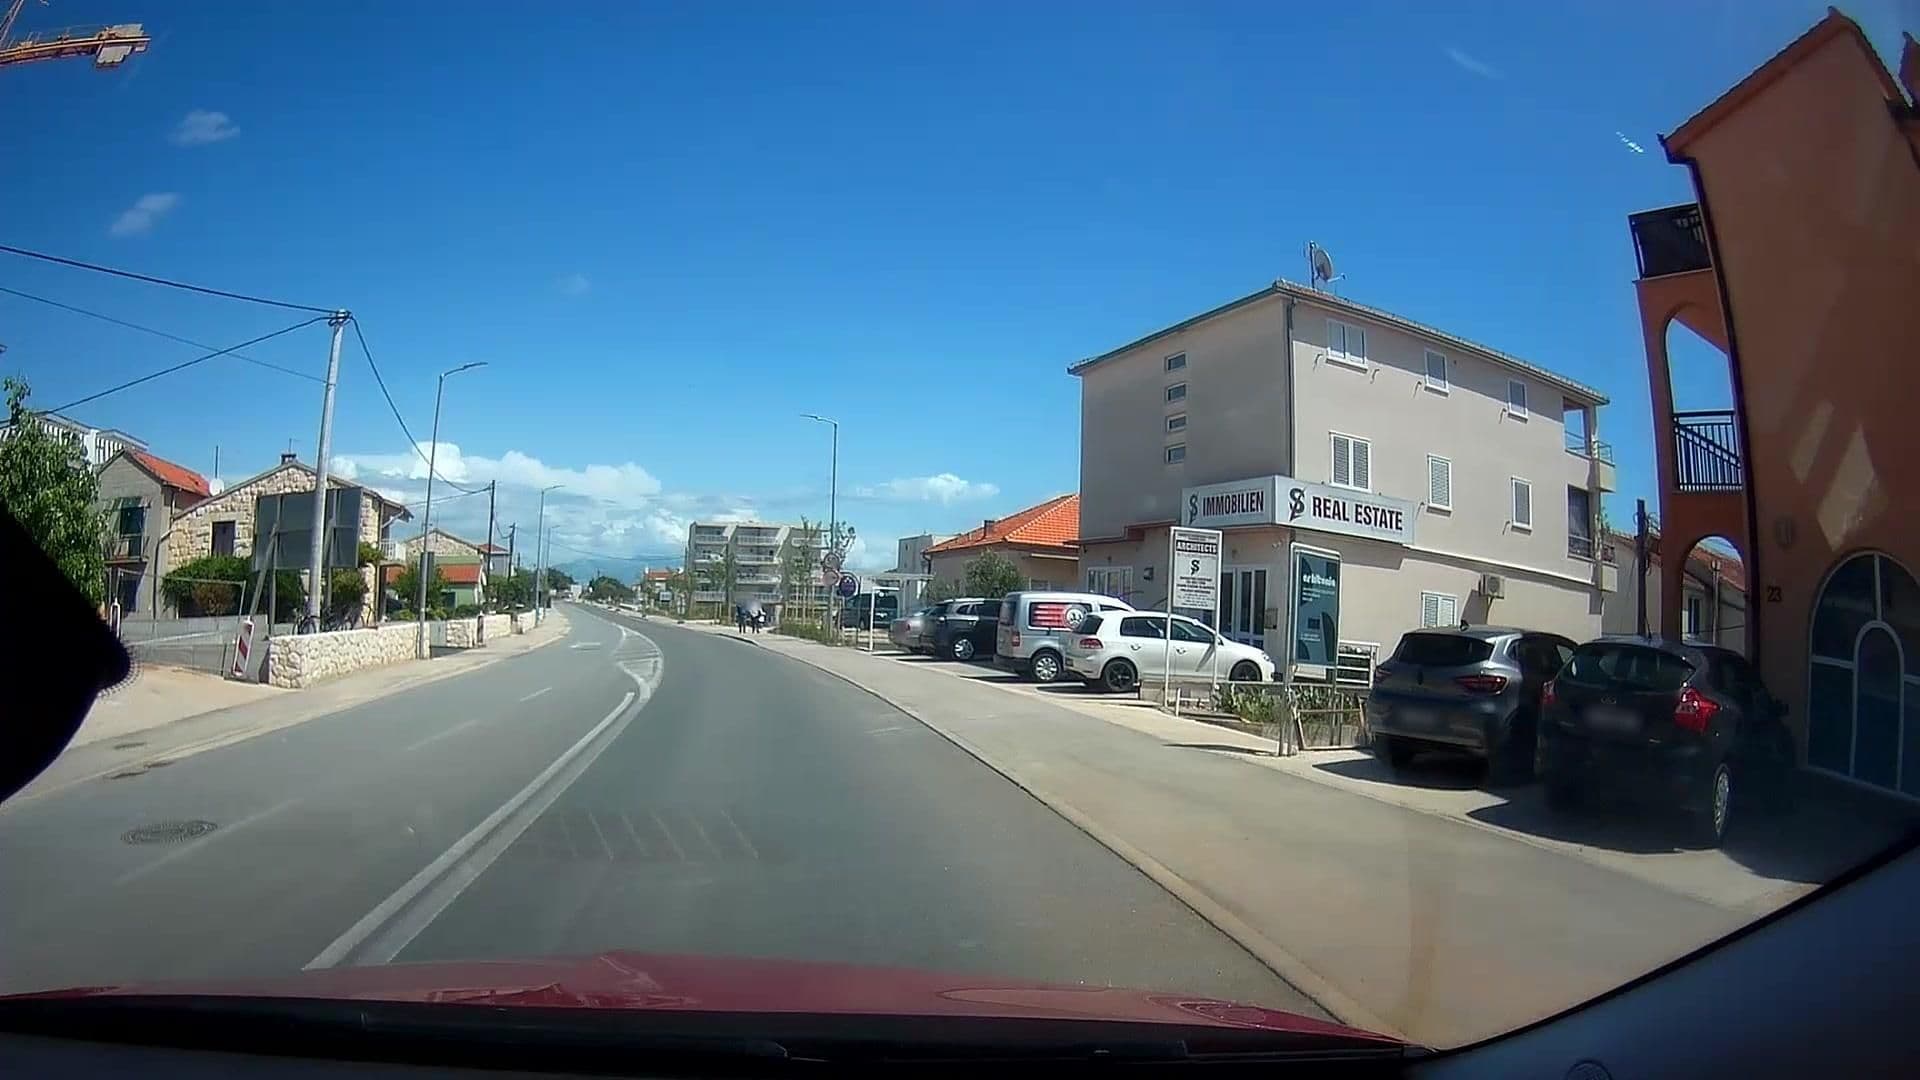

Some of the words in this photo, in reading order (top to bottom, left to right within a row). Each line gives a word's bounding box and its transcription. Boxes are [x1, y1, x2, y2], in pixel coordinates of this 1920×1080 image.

[1202, 490, 1264, 517] IMMOBILIEN
[1312, 496, 1350, 522] REAL
[1354, 503, 1403, 531] ESTATE
[1767, 585, 1782, 602] 23
